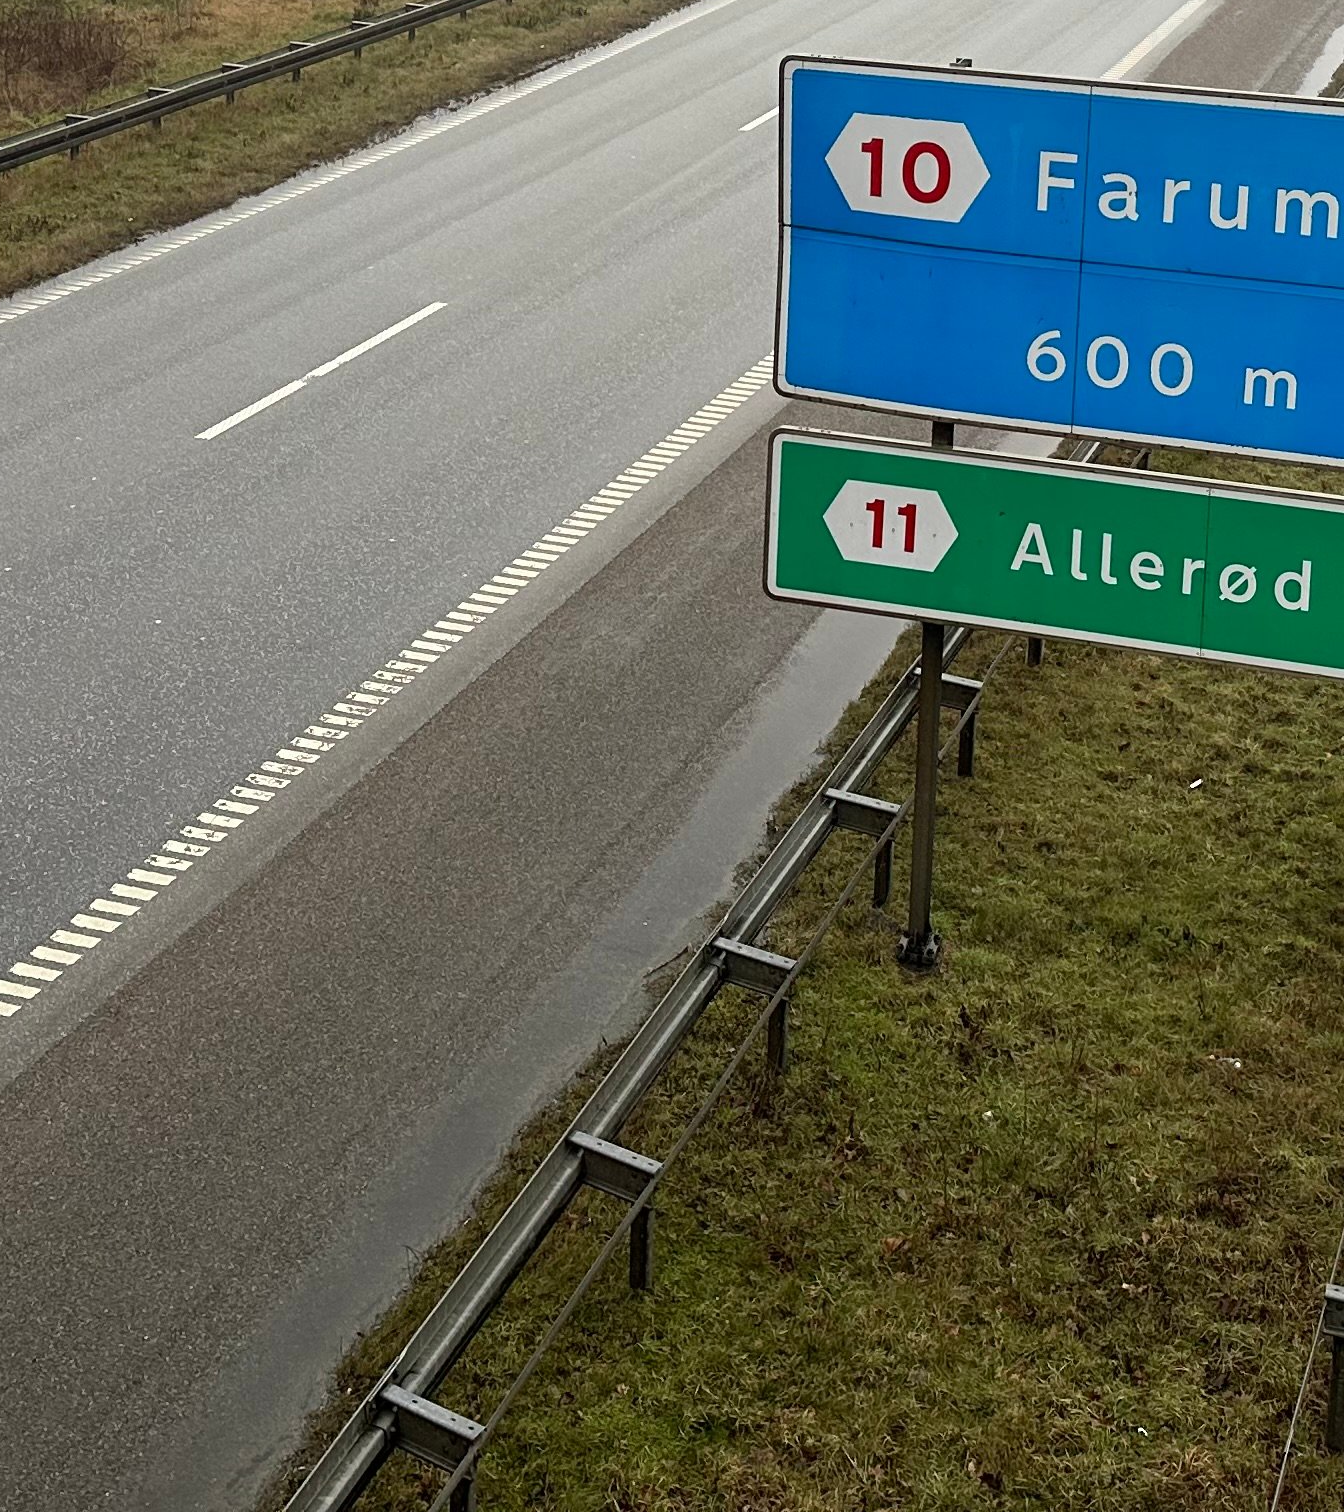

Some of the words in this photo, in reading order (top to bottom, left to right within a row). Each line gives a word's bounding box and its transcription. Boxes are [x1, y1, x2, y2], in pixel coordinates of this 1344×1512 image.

[862, 139, 950, 203] 10
[1036, 150, 1341, 239] Farum
[1026, 330, 1194, 398] 600
[1243, 366, 1298, 410] m
[867, 500, 916, 552] 11
[1009, 521, 1313, 613] Allerød
